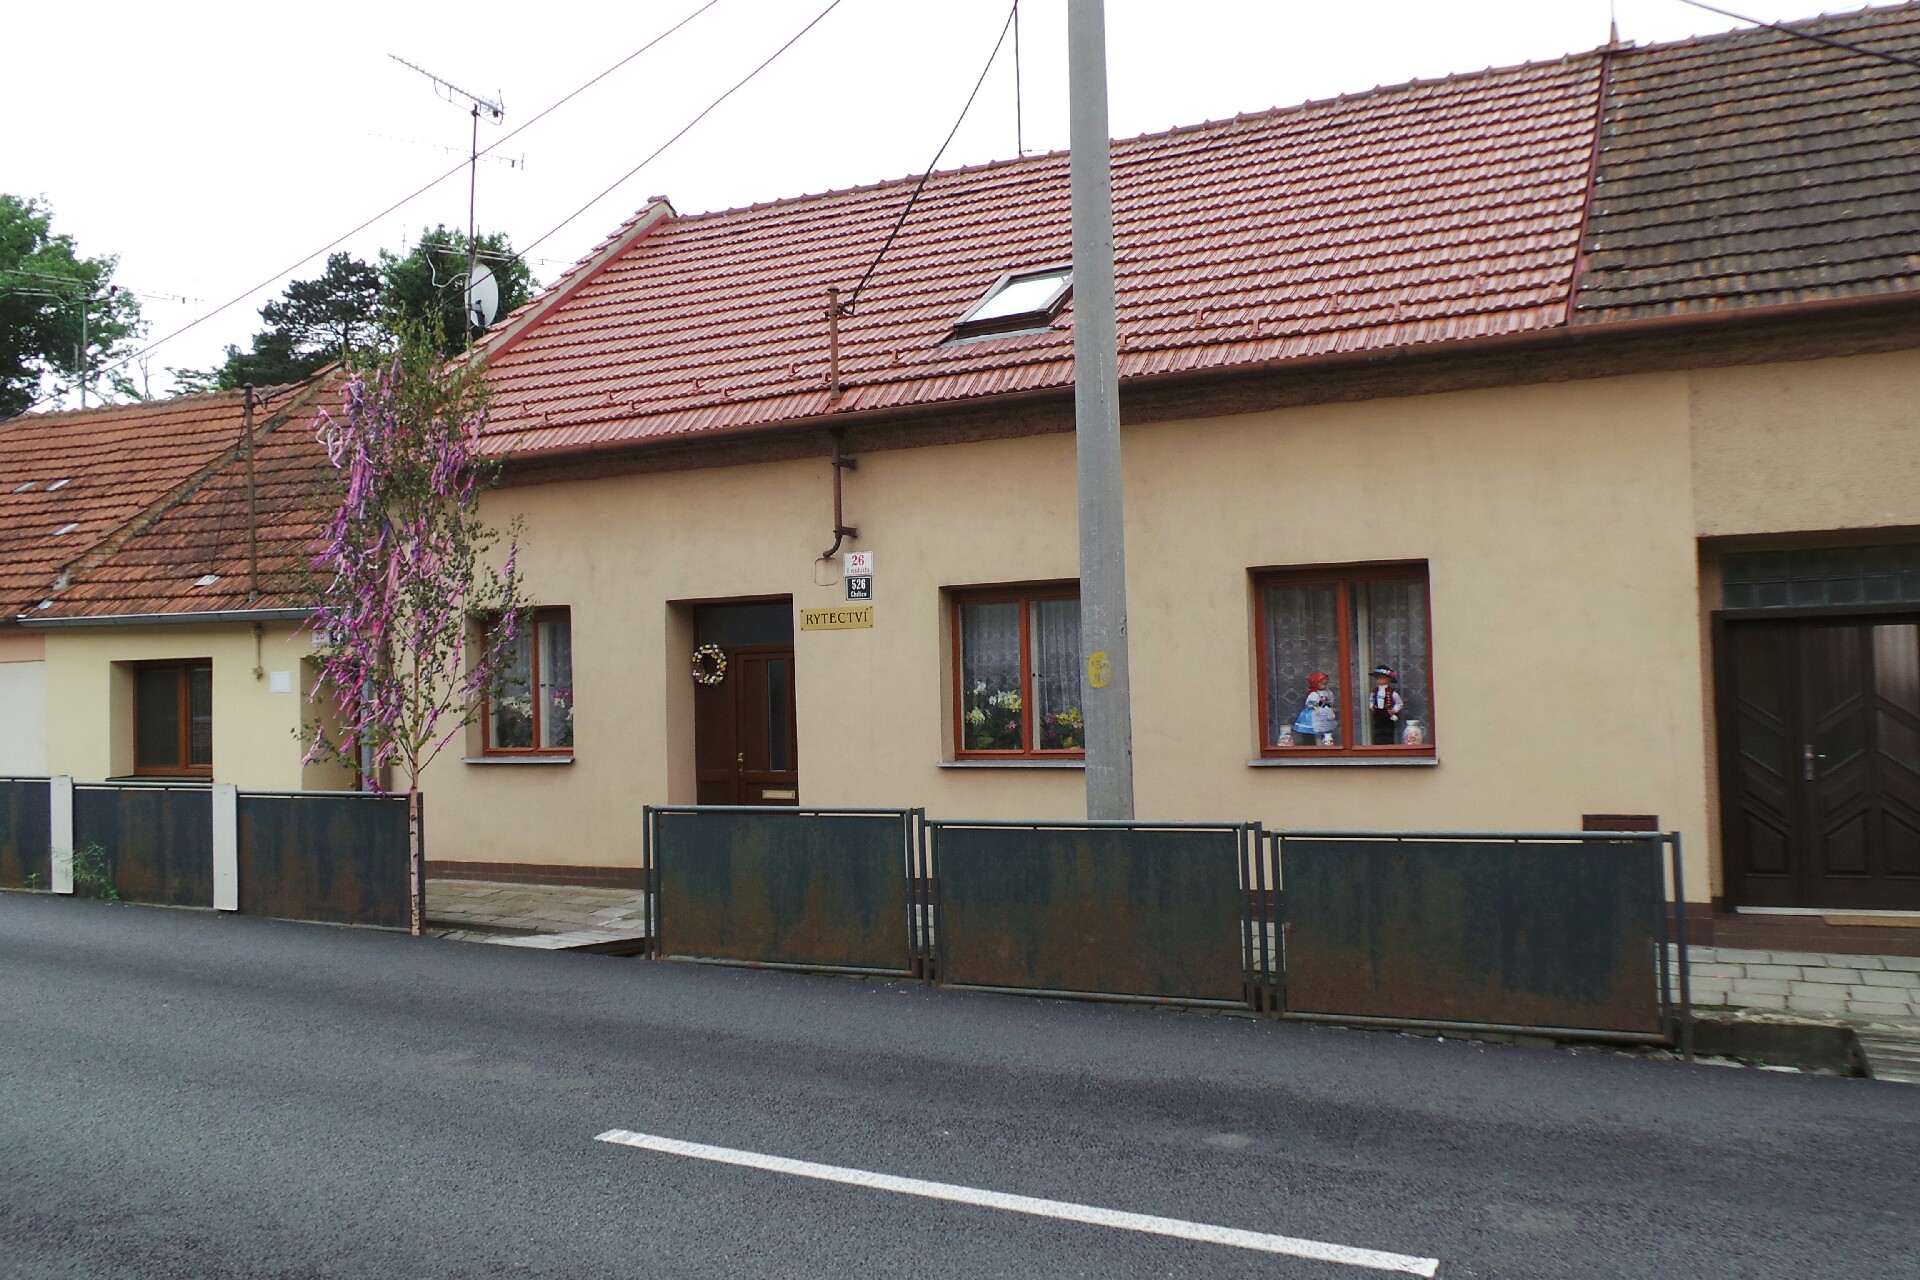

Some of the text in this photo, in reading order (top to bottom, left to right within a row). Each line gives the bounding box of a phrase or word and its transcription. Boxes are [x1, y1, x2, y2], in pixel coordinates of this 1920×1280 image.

[851, 554, 865, 566] 26
[851, 578, 866, 590] 526
[806, 607, 868, 625] RYTECTVÍ
